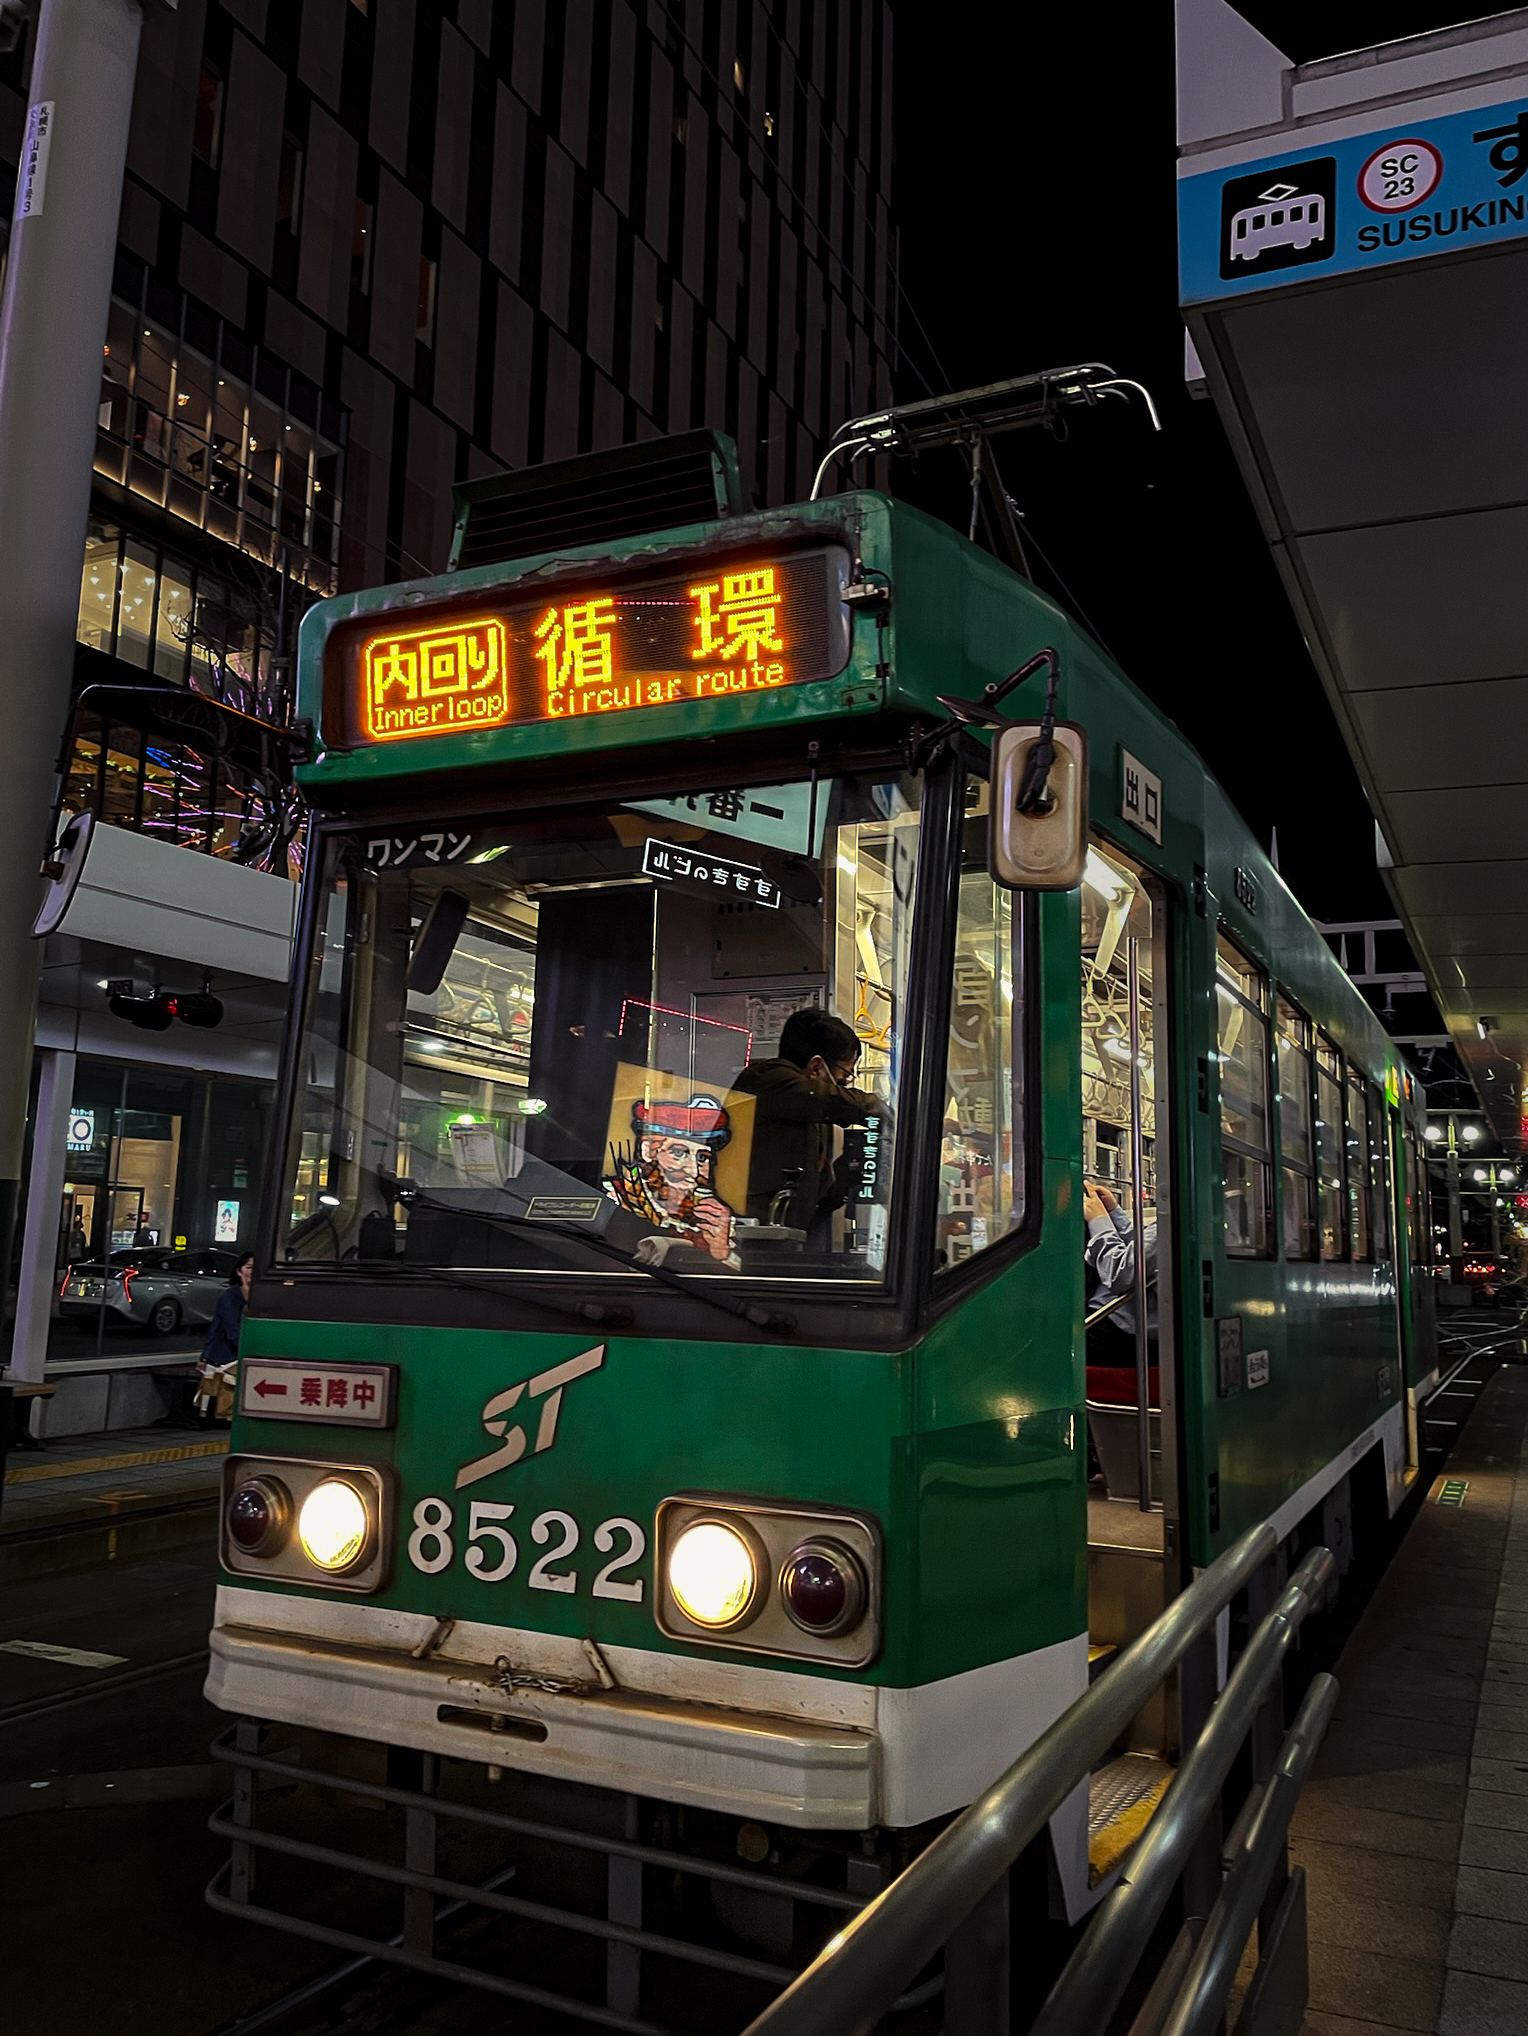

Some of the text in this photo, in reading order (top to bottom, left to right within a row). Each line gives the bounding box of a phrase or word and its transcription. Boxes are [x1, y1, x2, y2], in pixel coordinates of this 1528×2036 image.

[1381, 154, 1419, 178] SC
[1384, 177, 1415, 200] 23
[1358, 195, 1528, 252] SUSUKIN
[374, 628, 499, 704] 内回り
[697, 661, 784, 695] route
[1126, 767, 1158, 829] 出口
[367, 833, 471, 867] ワンマン
[300, 1377, 375, 1410] 乗降中
[407, 1497, 646, 1603] 8522
